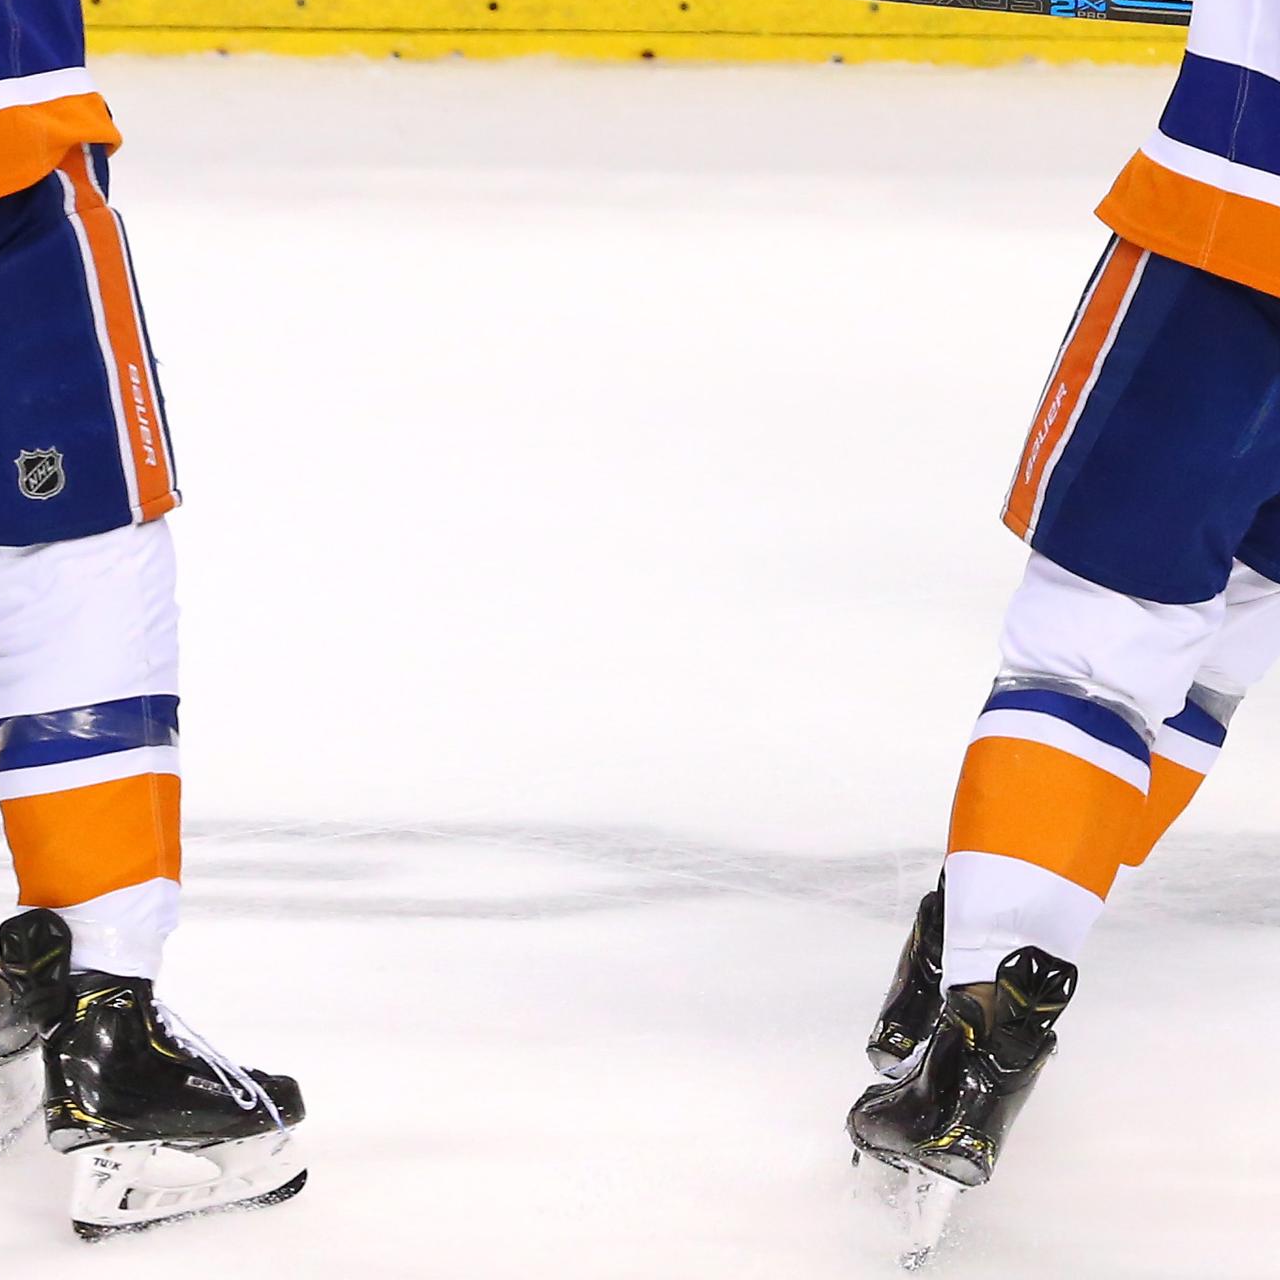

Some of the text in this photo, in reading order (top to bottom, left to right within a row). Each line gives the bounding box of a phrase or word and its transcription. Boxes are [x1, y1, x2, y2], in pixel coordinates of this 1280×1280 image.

[1077, 10, 1108, 20] PRO
[128, 363, 157, 466] BAUER
[1025, 382, 1068, 485] BAUER
[28, 458, 55, 489] NHL
